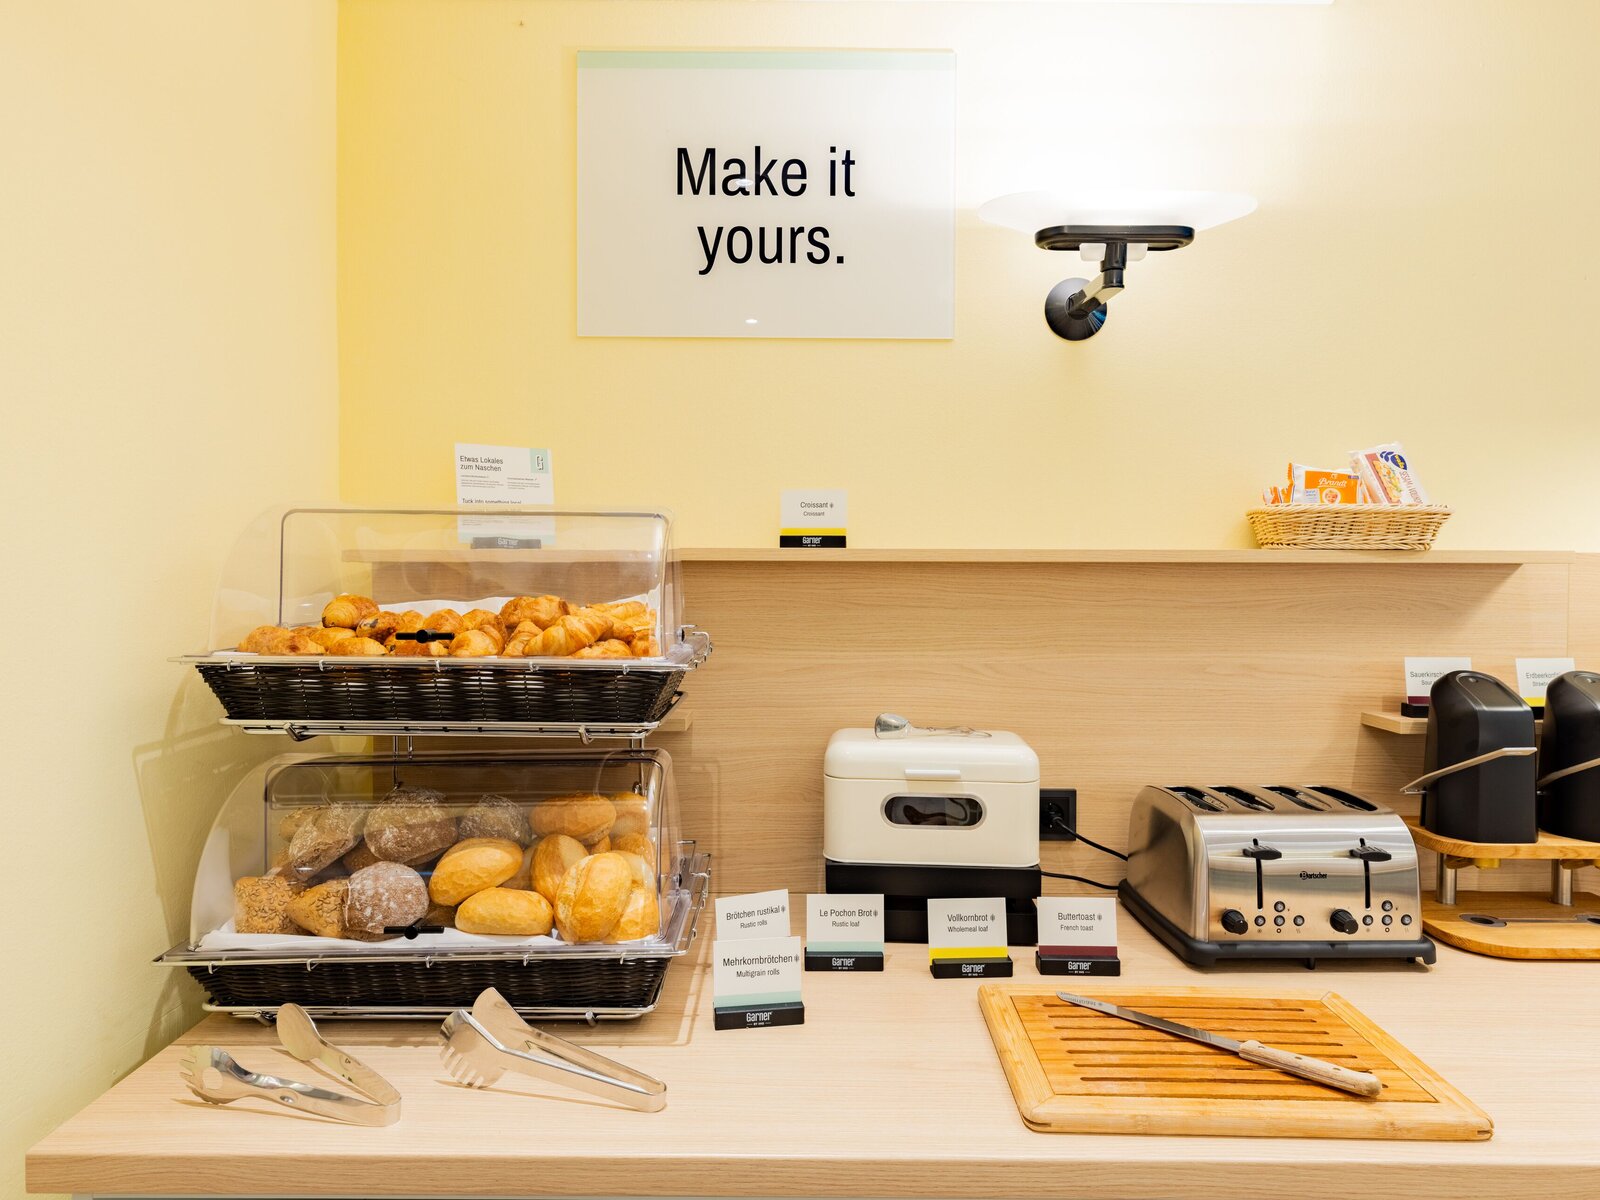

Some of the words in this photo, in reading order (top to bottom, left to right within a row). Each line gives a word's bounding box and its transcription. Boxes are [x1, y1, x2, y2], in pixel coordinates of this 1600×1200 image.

[676, 146, 807, 197] Make
[828, 146, 856, 197] it
[696, 225, 845, 276] yours.
[1318, 478, 1348, 488] Brandt
[802, 536, 822, 544] Garner
[726, 910, 756, 921] Brötchen
[756, 906, 781, 916] rustikal
[819, 909, 828, 917] Le
[829, 909, 856, 917] Pochon
[857, 909, 873, 917] Brot
[1057, 912, 1096, 921] Buttertoast
[947, 914, 988, 922] Vollkornbrot
[722, 954, 793, 967] Mehrkornbrötchen
[832, 958, 855, 966] Garner
[962, 964, 985, 973] Garner
[1068, 961, 1091, 970] Garner
[736, 970, 766, 978] Multigrain
[746, 1012, 772, 1022] Garner
